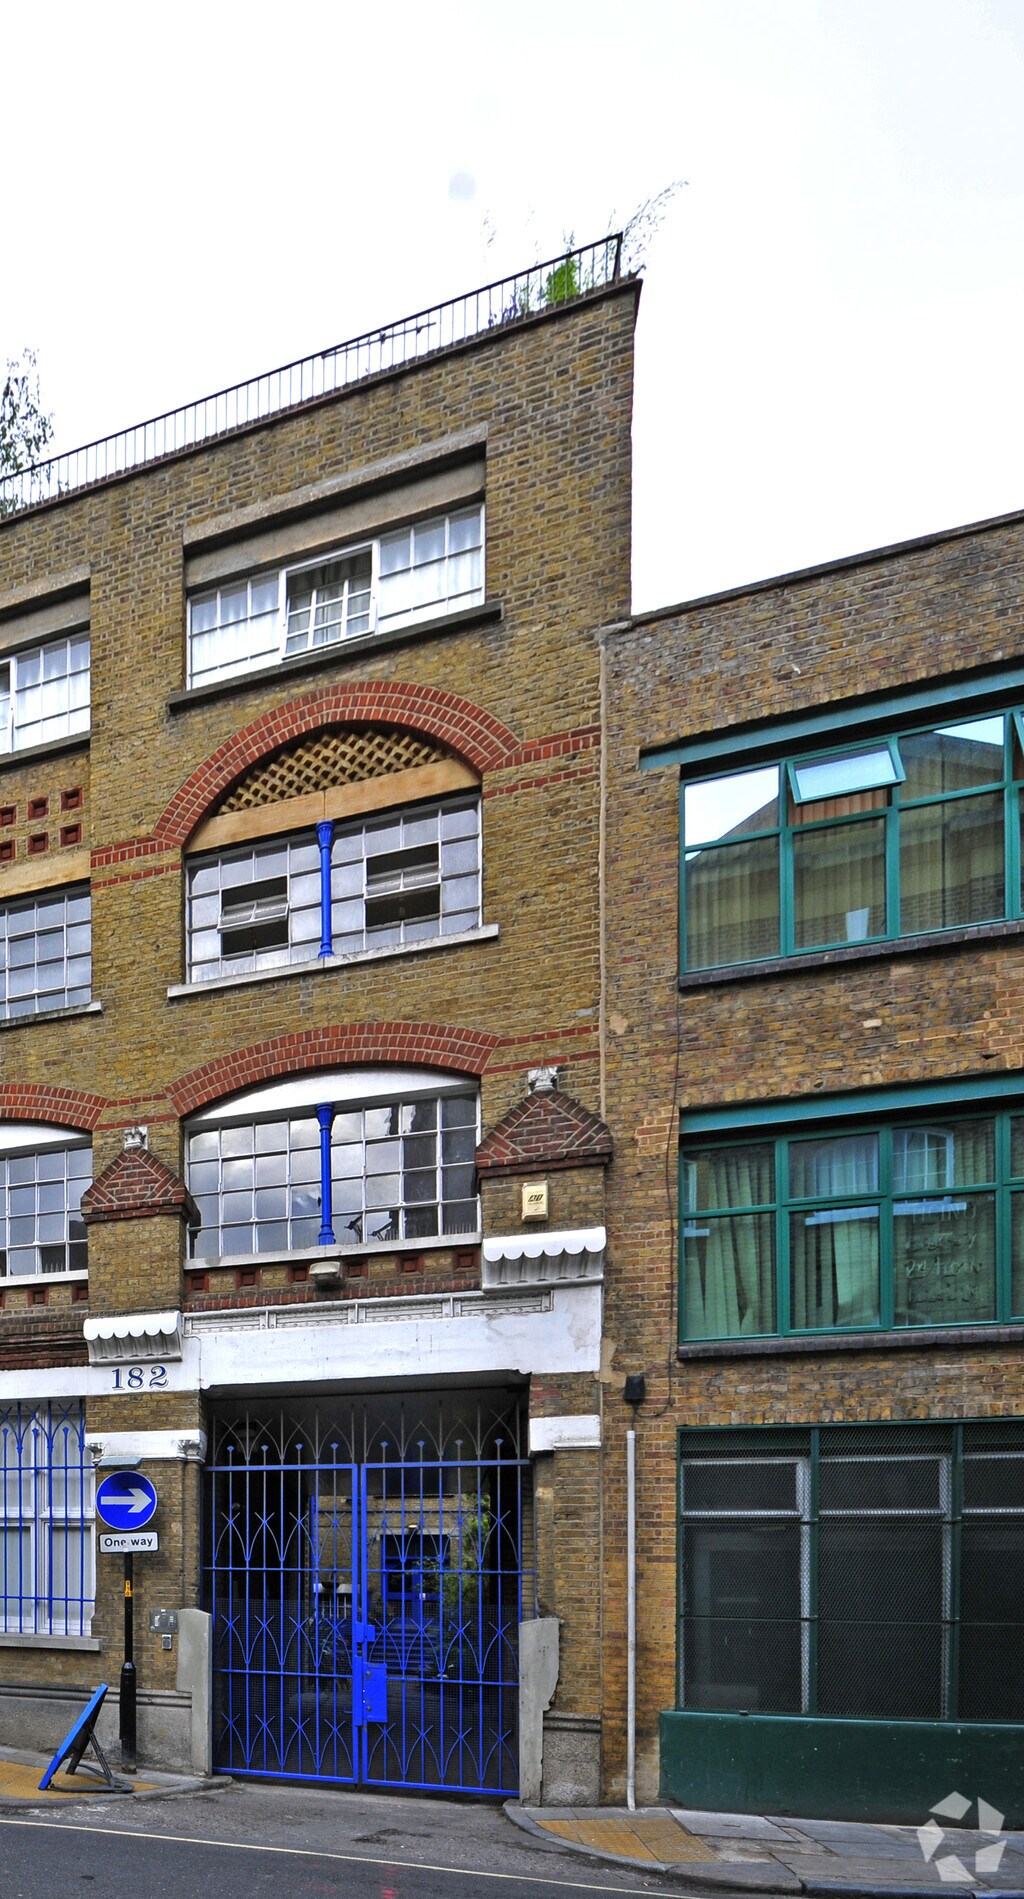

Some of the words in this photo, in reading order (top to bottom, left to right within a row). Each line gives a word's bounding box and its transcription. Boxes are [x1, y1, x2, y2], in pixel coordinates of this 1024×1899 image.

[112, 1366, 169, 1390] 182
[104, 1537, 127, 1547] One
[130, 1537, 153, 1547] way
